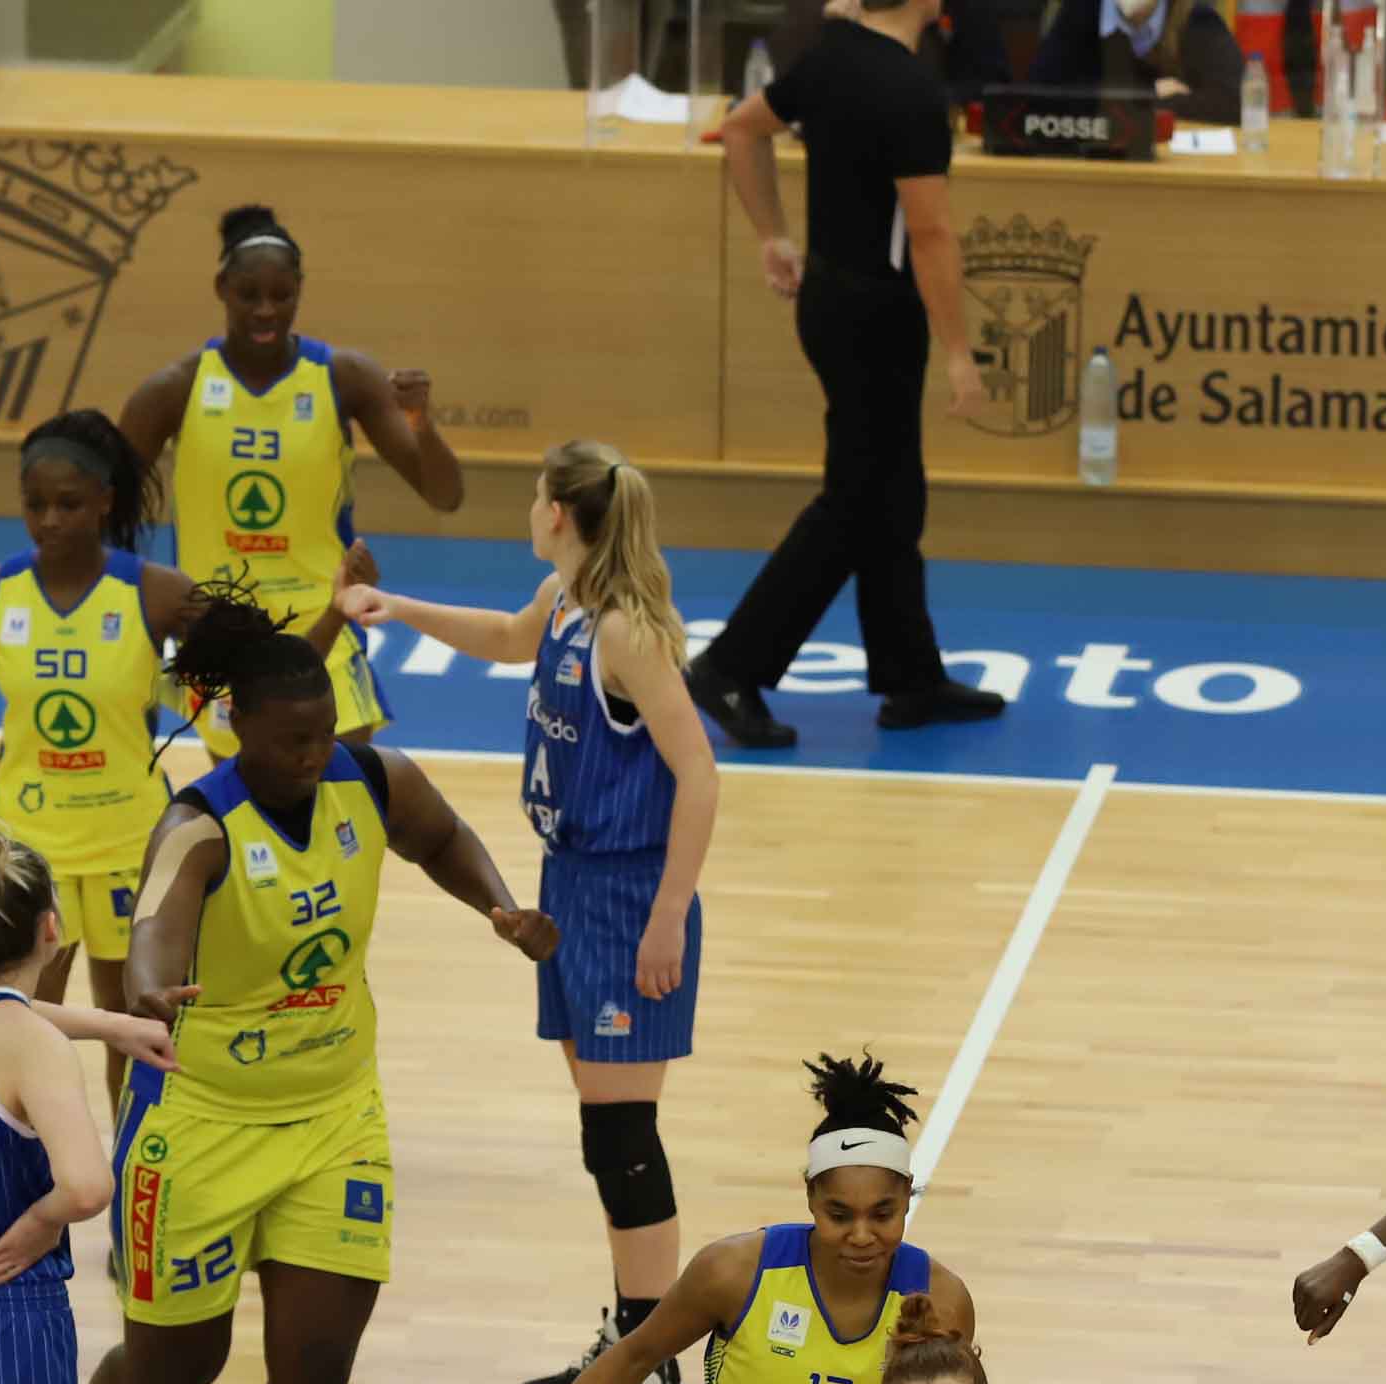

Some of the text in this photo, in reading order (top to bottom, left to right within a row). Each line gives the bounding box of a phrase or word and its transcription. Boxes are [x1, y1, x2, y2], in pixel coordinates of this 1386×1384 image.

[1024, 114, 1110, 140] POSSE
[1116, 368, 1177, 423] de
[231, 427, 281, 460] 23
[35, 649, 87, 680] 50
[290, 880, 342, 926] 32
[134, 1168, 155, 1273] SPAR
[170, 1234, 237, 1293] 32
